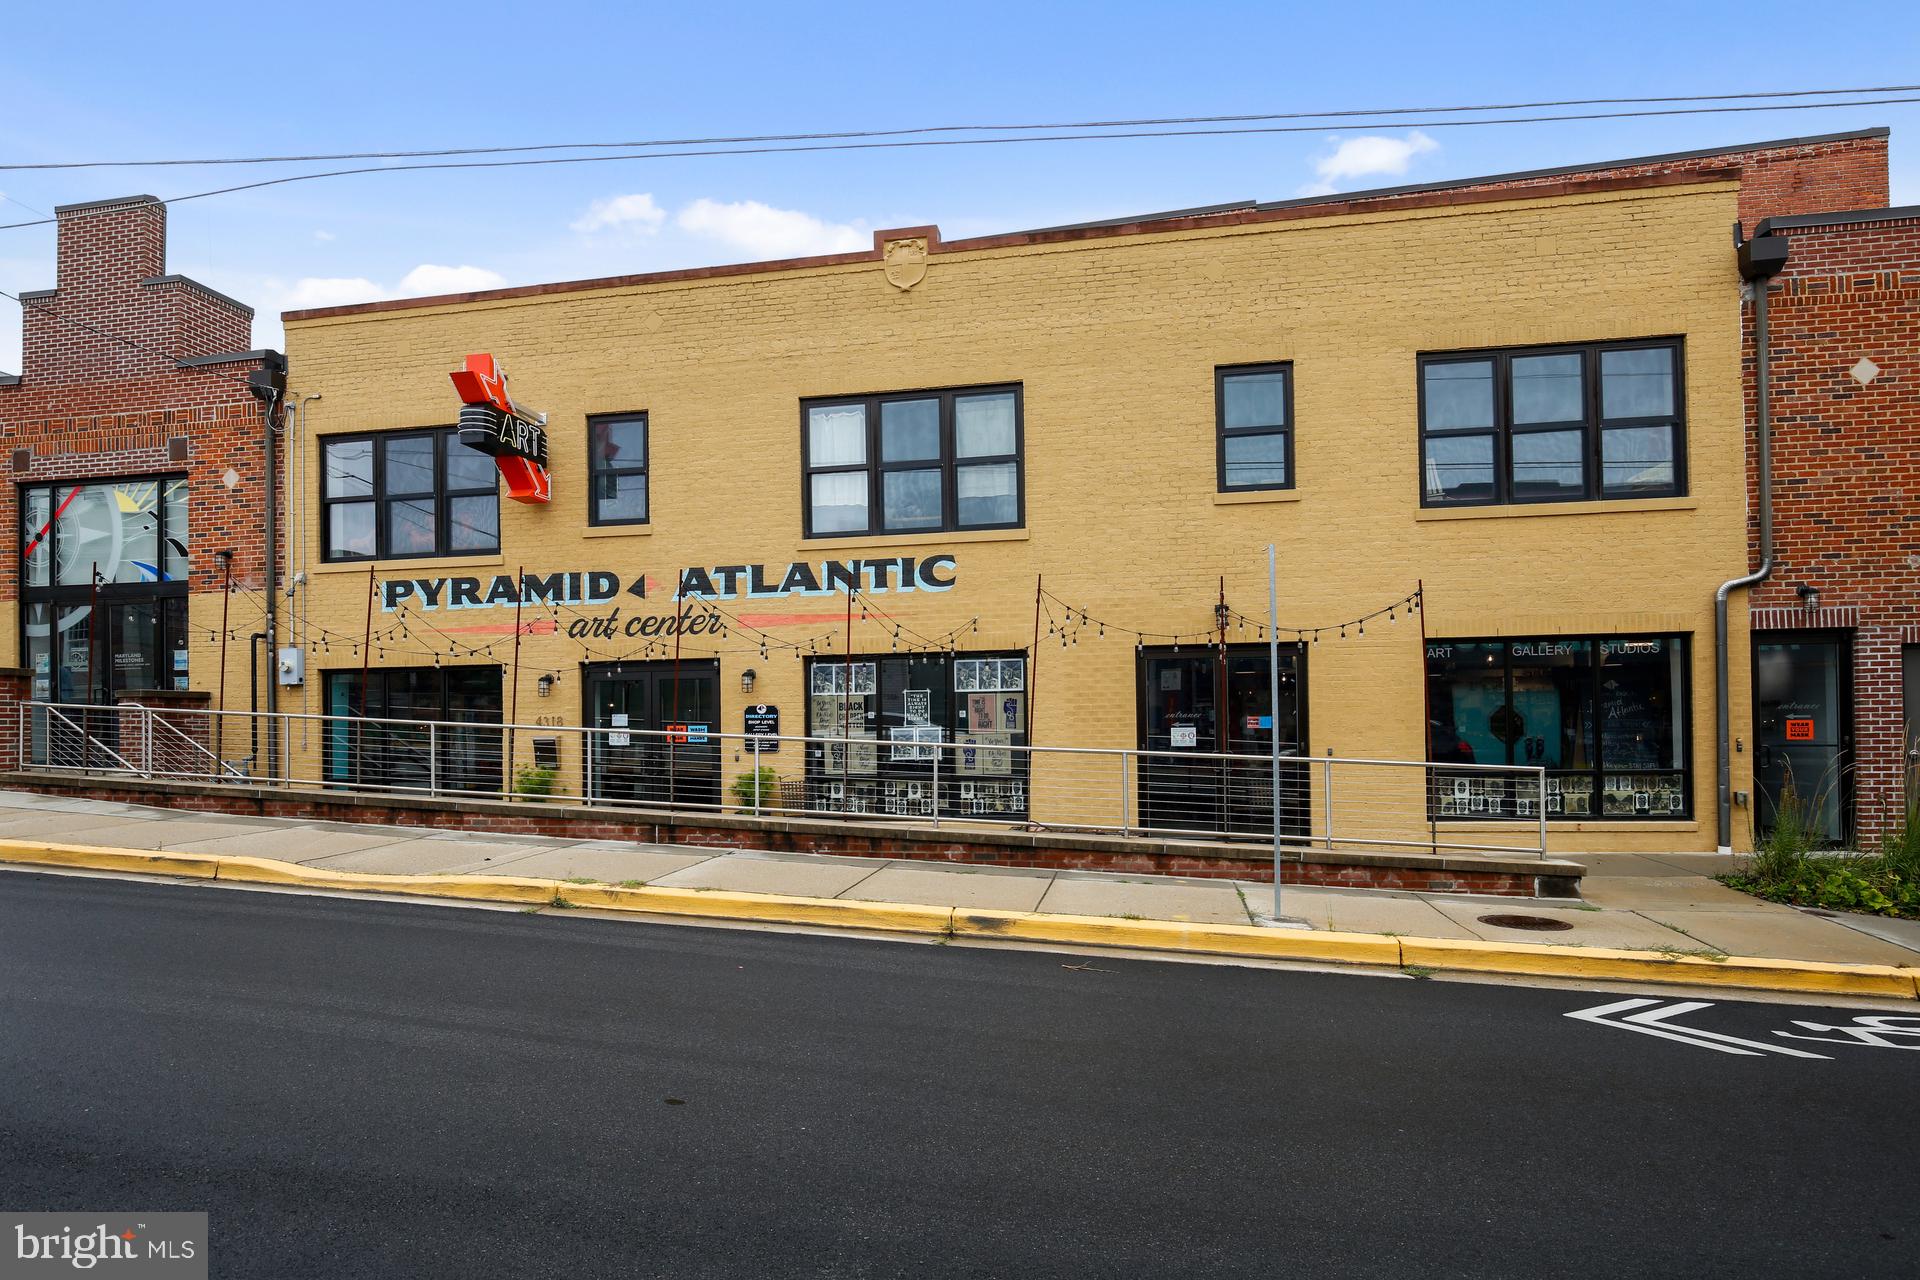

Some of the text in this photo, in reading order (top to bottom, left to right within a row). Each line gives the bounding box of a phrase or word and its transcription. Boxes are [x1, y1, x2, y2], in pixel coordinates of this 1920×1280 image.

[500, 413, 541, 457] ART
[382, 554, 957, 612] PYRAMID ATLANTIC
[568, 603, 724, 639] art center
[1427, 643, 1660, 659] ART GALLERY STUDIOS
[839, 702, 863, 711] BLACK
[1776, 701, 1821, 710] entrance
[535, 715, 564, 727] 4318
[1165, 710, 1203, 719] entrance
